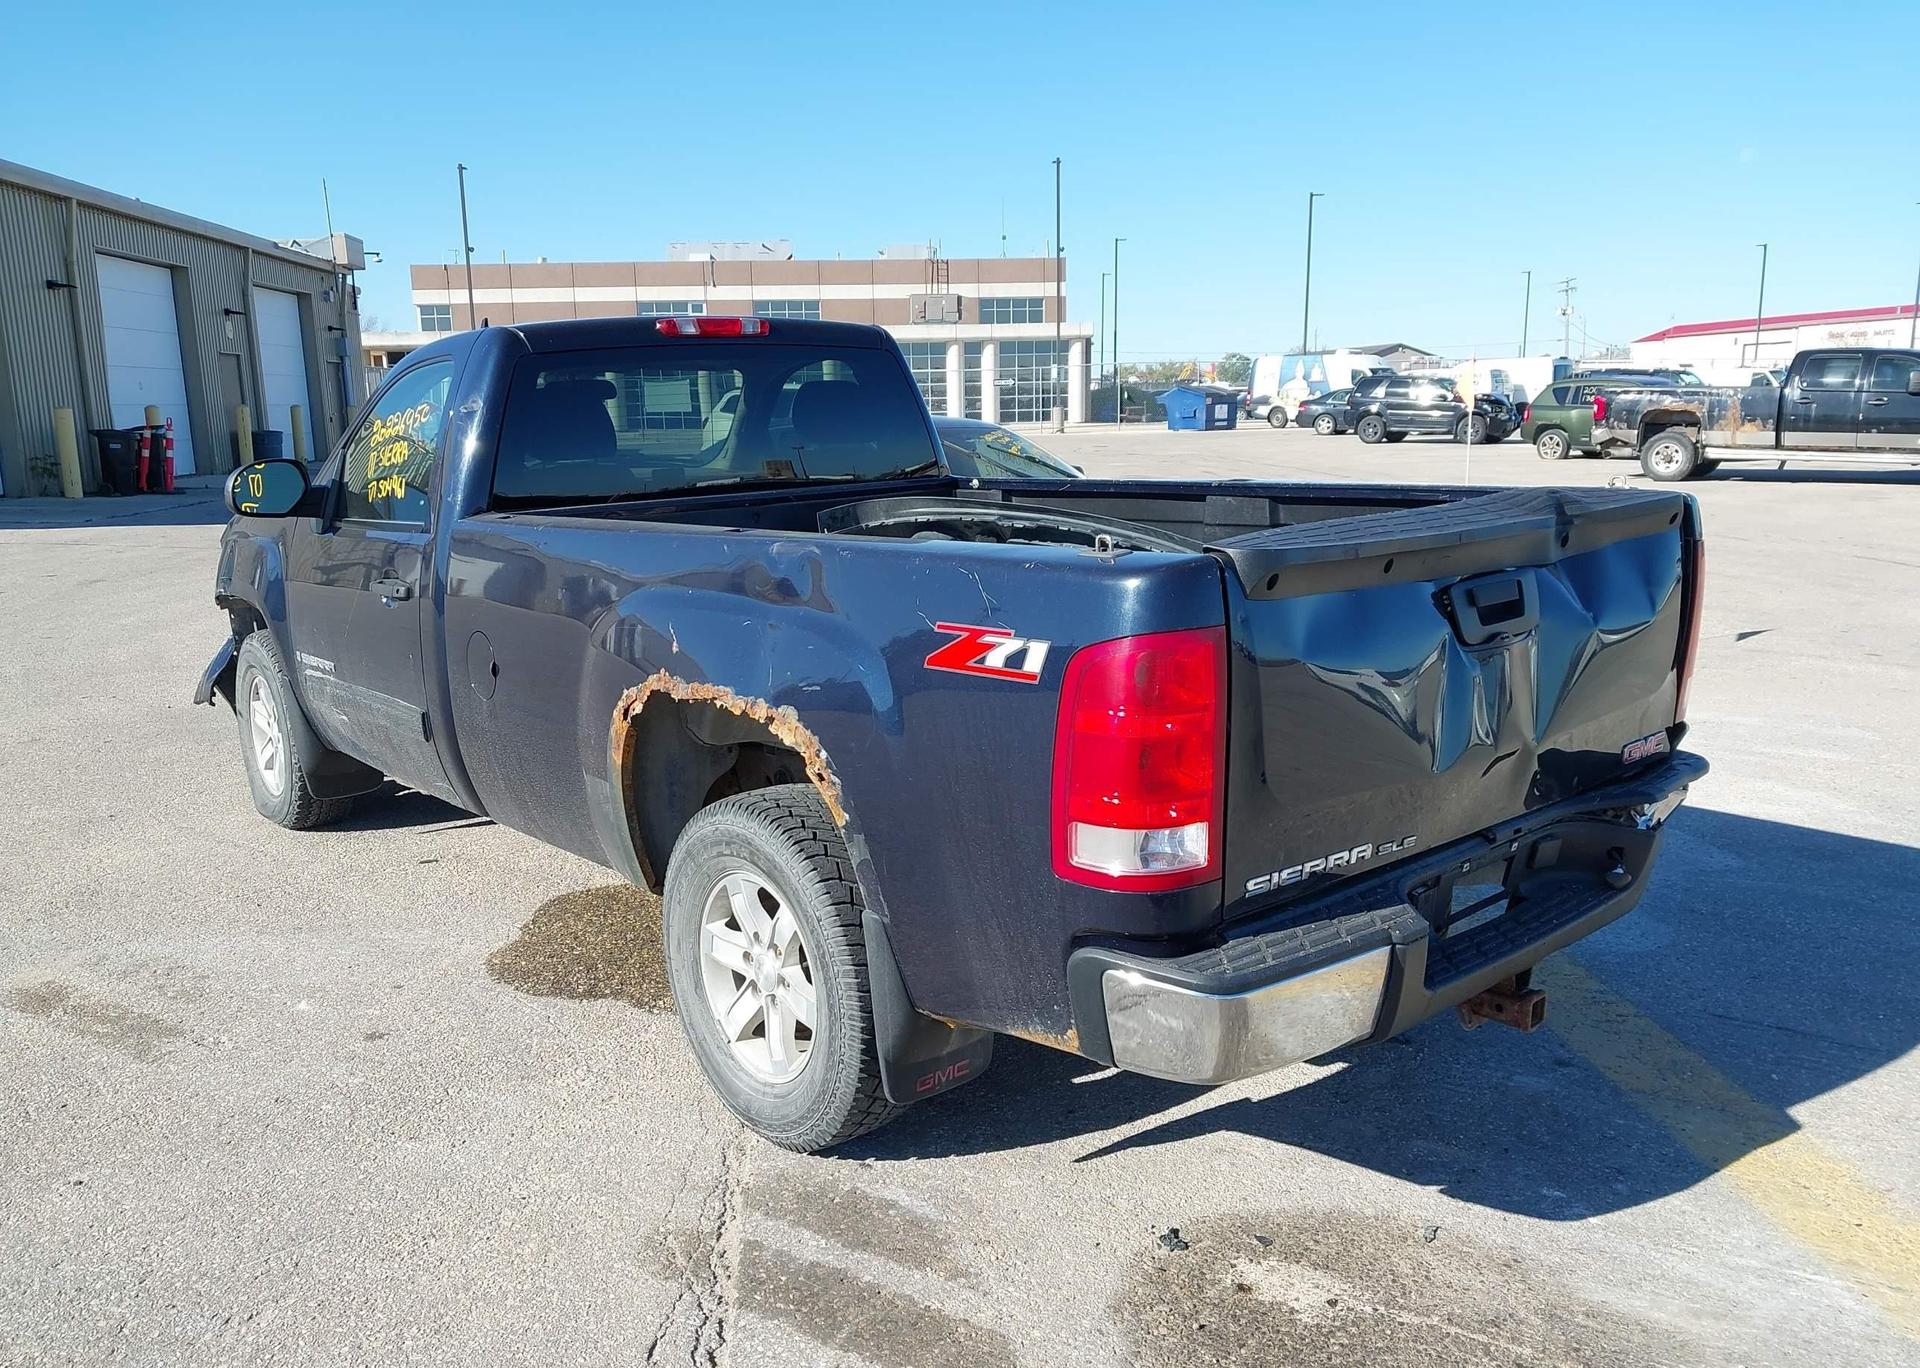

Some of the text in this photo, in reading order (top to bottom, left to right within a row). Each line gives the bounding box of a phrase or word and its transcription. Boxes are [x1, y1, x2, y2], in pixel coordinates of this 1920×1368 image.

[379, 440, 408, 466] SIERRA
[924, 621, 1051, 685] Z71
[1623, 730, 1667, 765] GMC
[1244, 835, 1417, 899] SIERRA SLE
[916, 1058, 970, 1093] GMC
